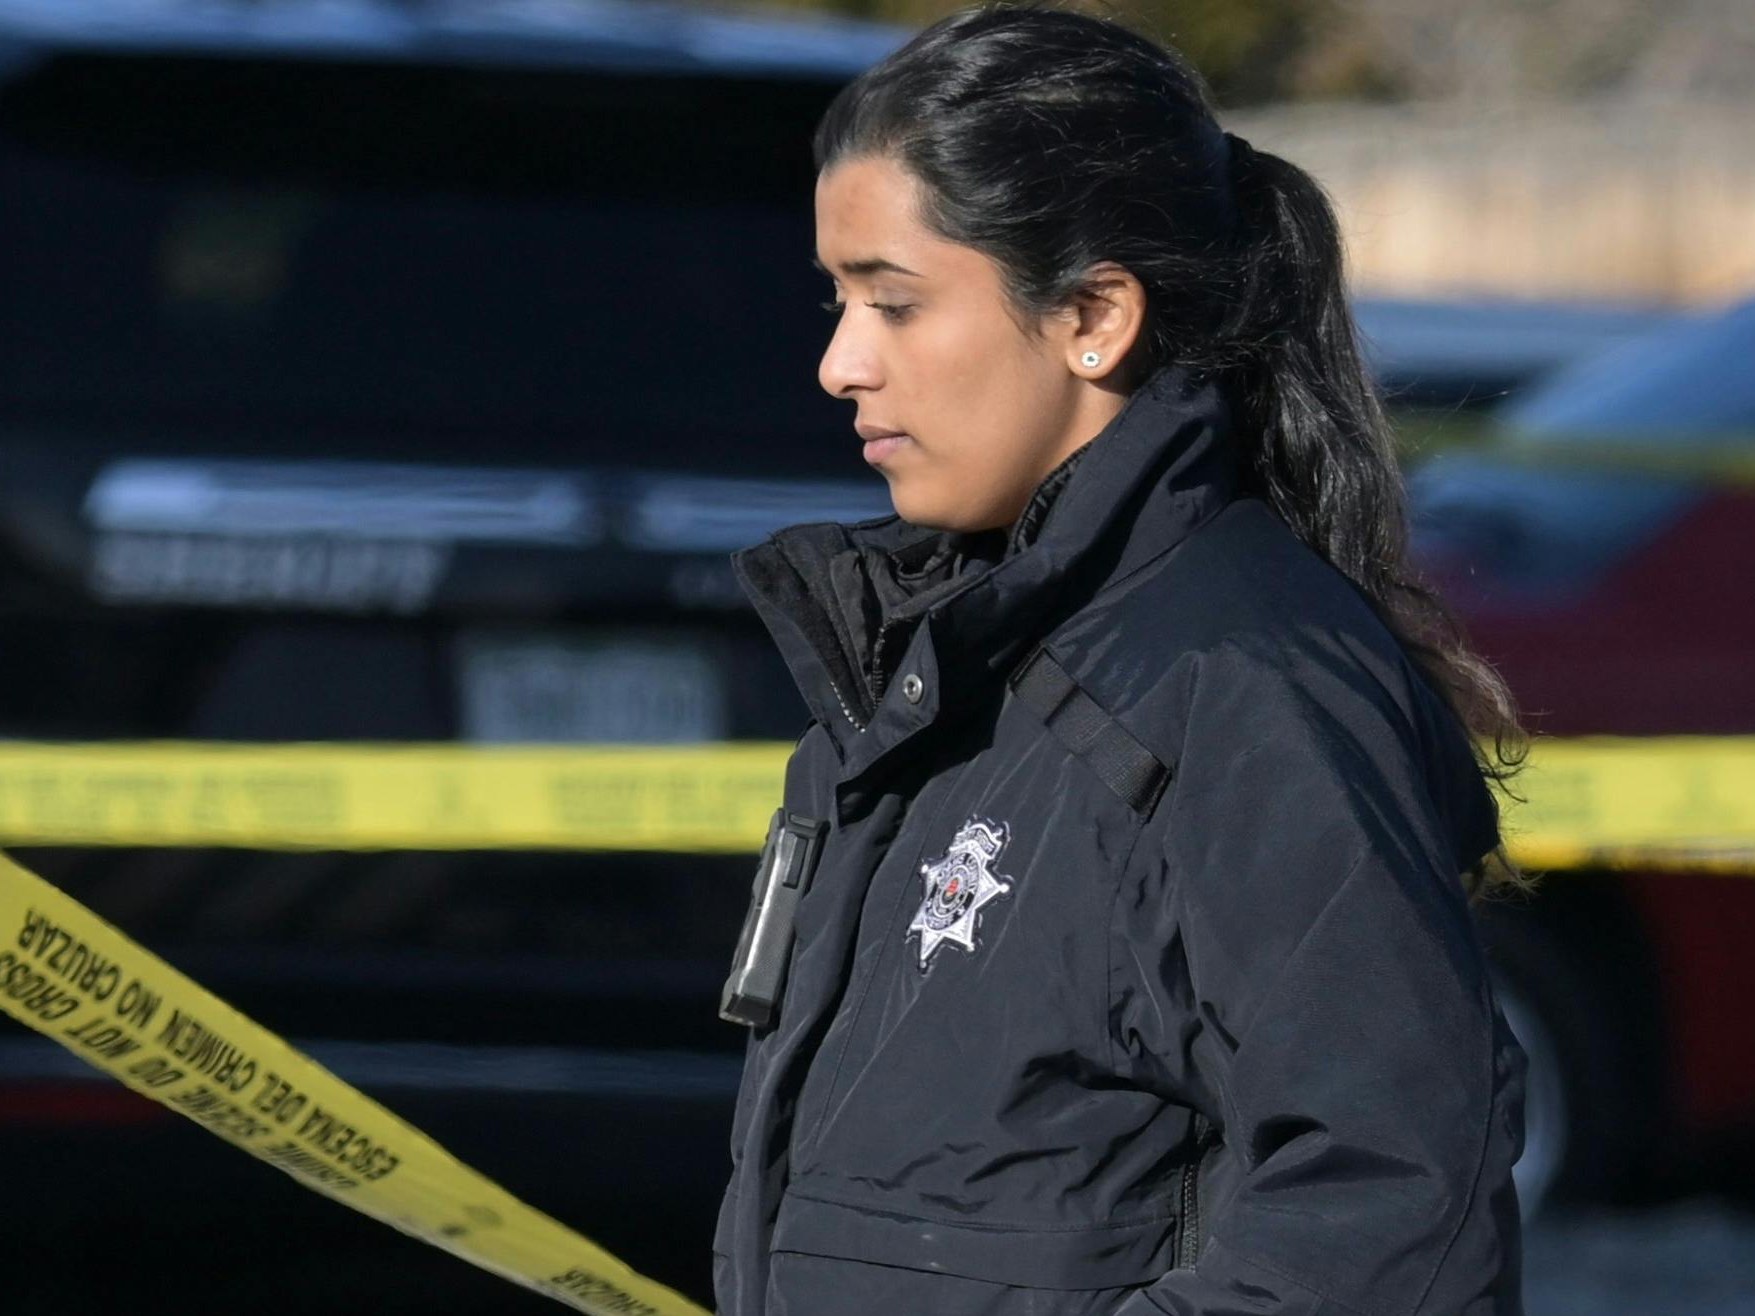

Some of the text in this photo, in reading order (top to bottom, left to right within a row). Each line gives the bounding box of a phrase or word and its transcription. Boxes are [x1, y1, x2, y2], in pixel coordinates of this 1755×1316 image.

[17, 911, 399, 1180] ESCENA DEL CRIMEN NO CRUZAR
[67, 1018, 140, 1062] NOT
[131, 1057, 185, 1091] DO
[170, 1085, 270, 1139] SCENE
